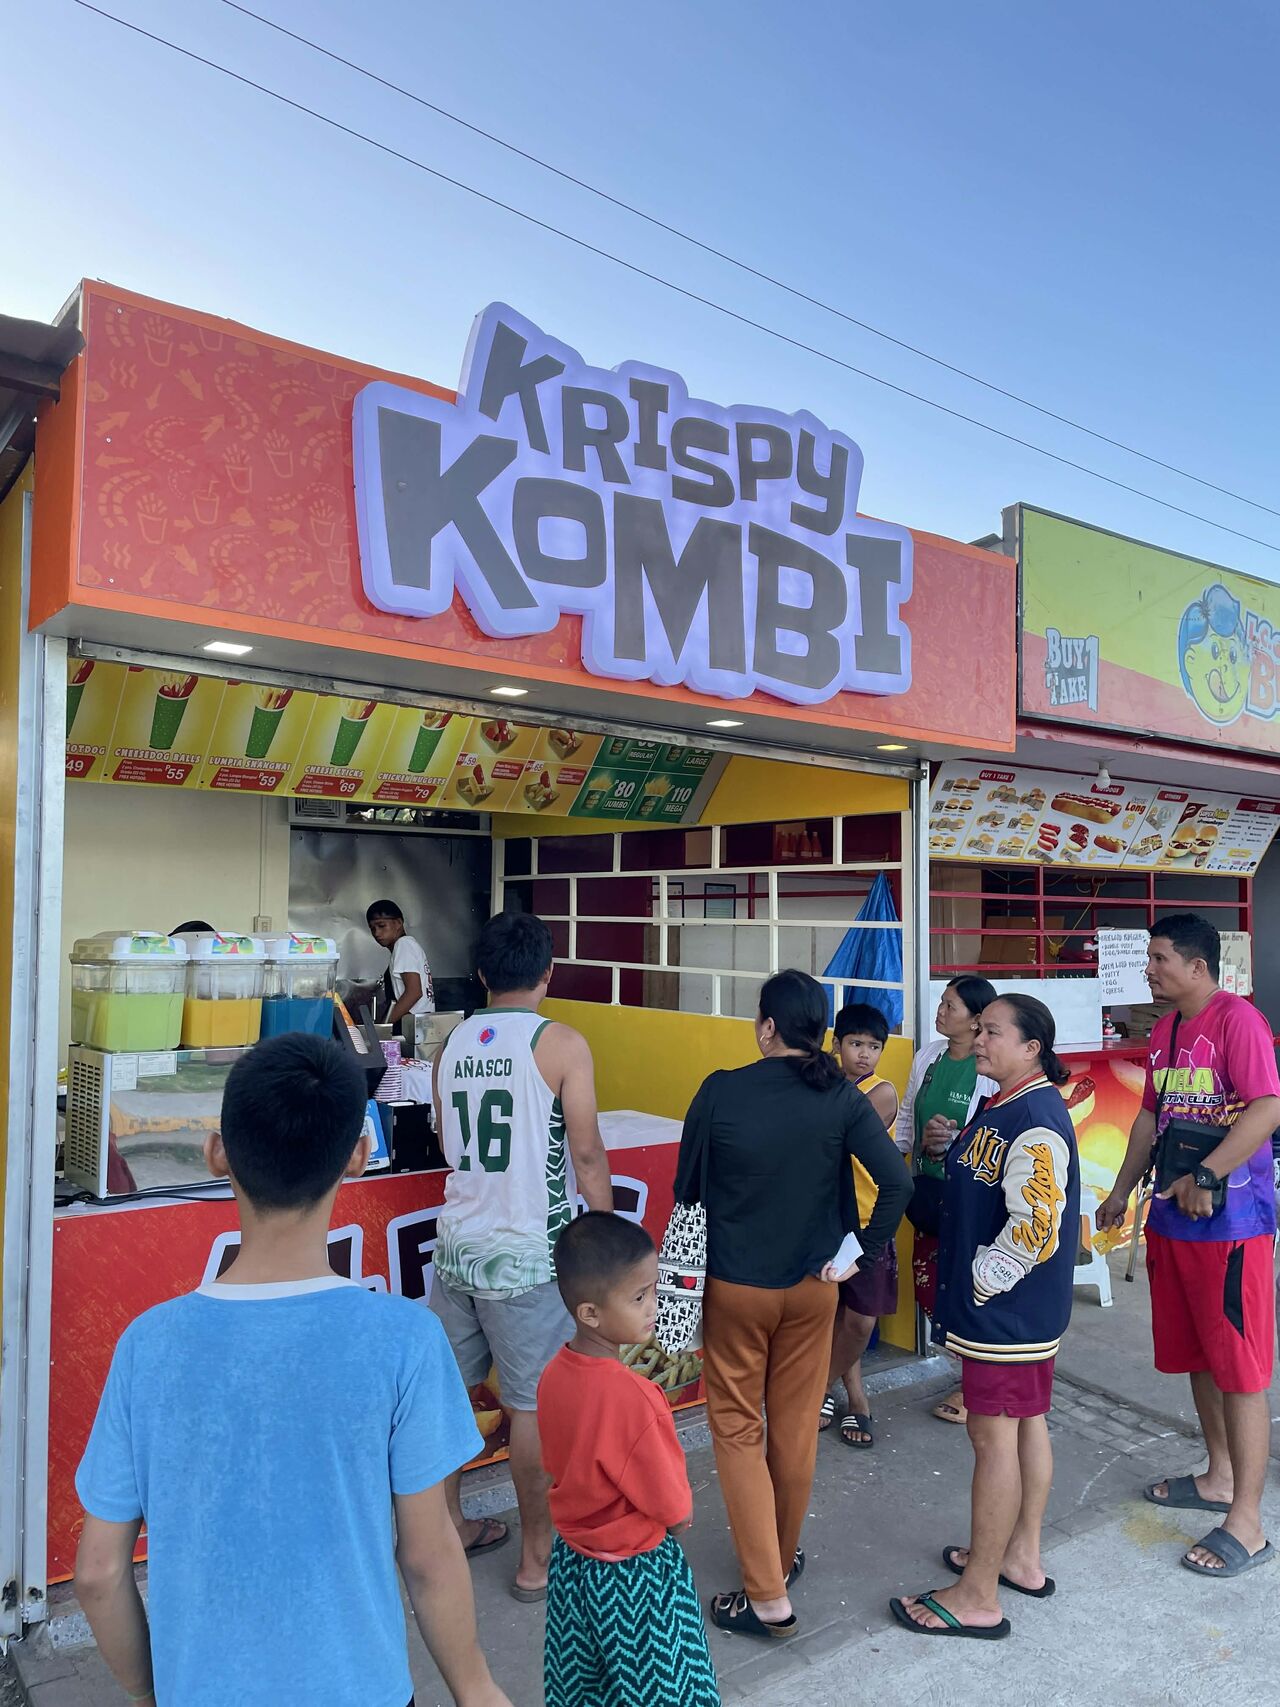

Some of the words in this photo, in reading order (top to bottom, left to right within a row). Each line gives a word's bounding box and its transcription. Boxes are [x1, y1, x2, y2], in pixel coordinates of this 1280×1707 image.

[478, 320, 849, 536] KRISPY
[377, 406, 902, 690] KOMBI
[1046, 628, 1085, 669] BUY
[1046, 673, 1087, 706] TAKE
[114, 748, 170, 761] CHEESEDOG
[172, 753, 201, 764] BALLS
[629, 750, 653, 759] REGULAR
[686, 758, 709, 766] LARGE
[209, 756, 243, 767] LUMPIA
[245, 759, 291, 771] SHANGHAI
[304, 765, 334, 776] CHEESE
[335, 768, 364, 778] STICKS
[377, 772, 411, 783] CHICKEN
[412, 775, 448, 785] NUGGETS
[605, 800, 628, 808] JUMBO
[664, 805, 683, 813] MEGA
[1125, 801, 1147, 815] Long
[454, 1055, 513, 1079] AÑASCO
[451, 1089, 514, 1173] 16
[957, 1126, 1008, 1186] NY
